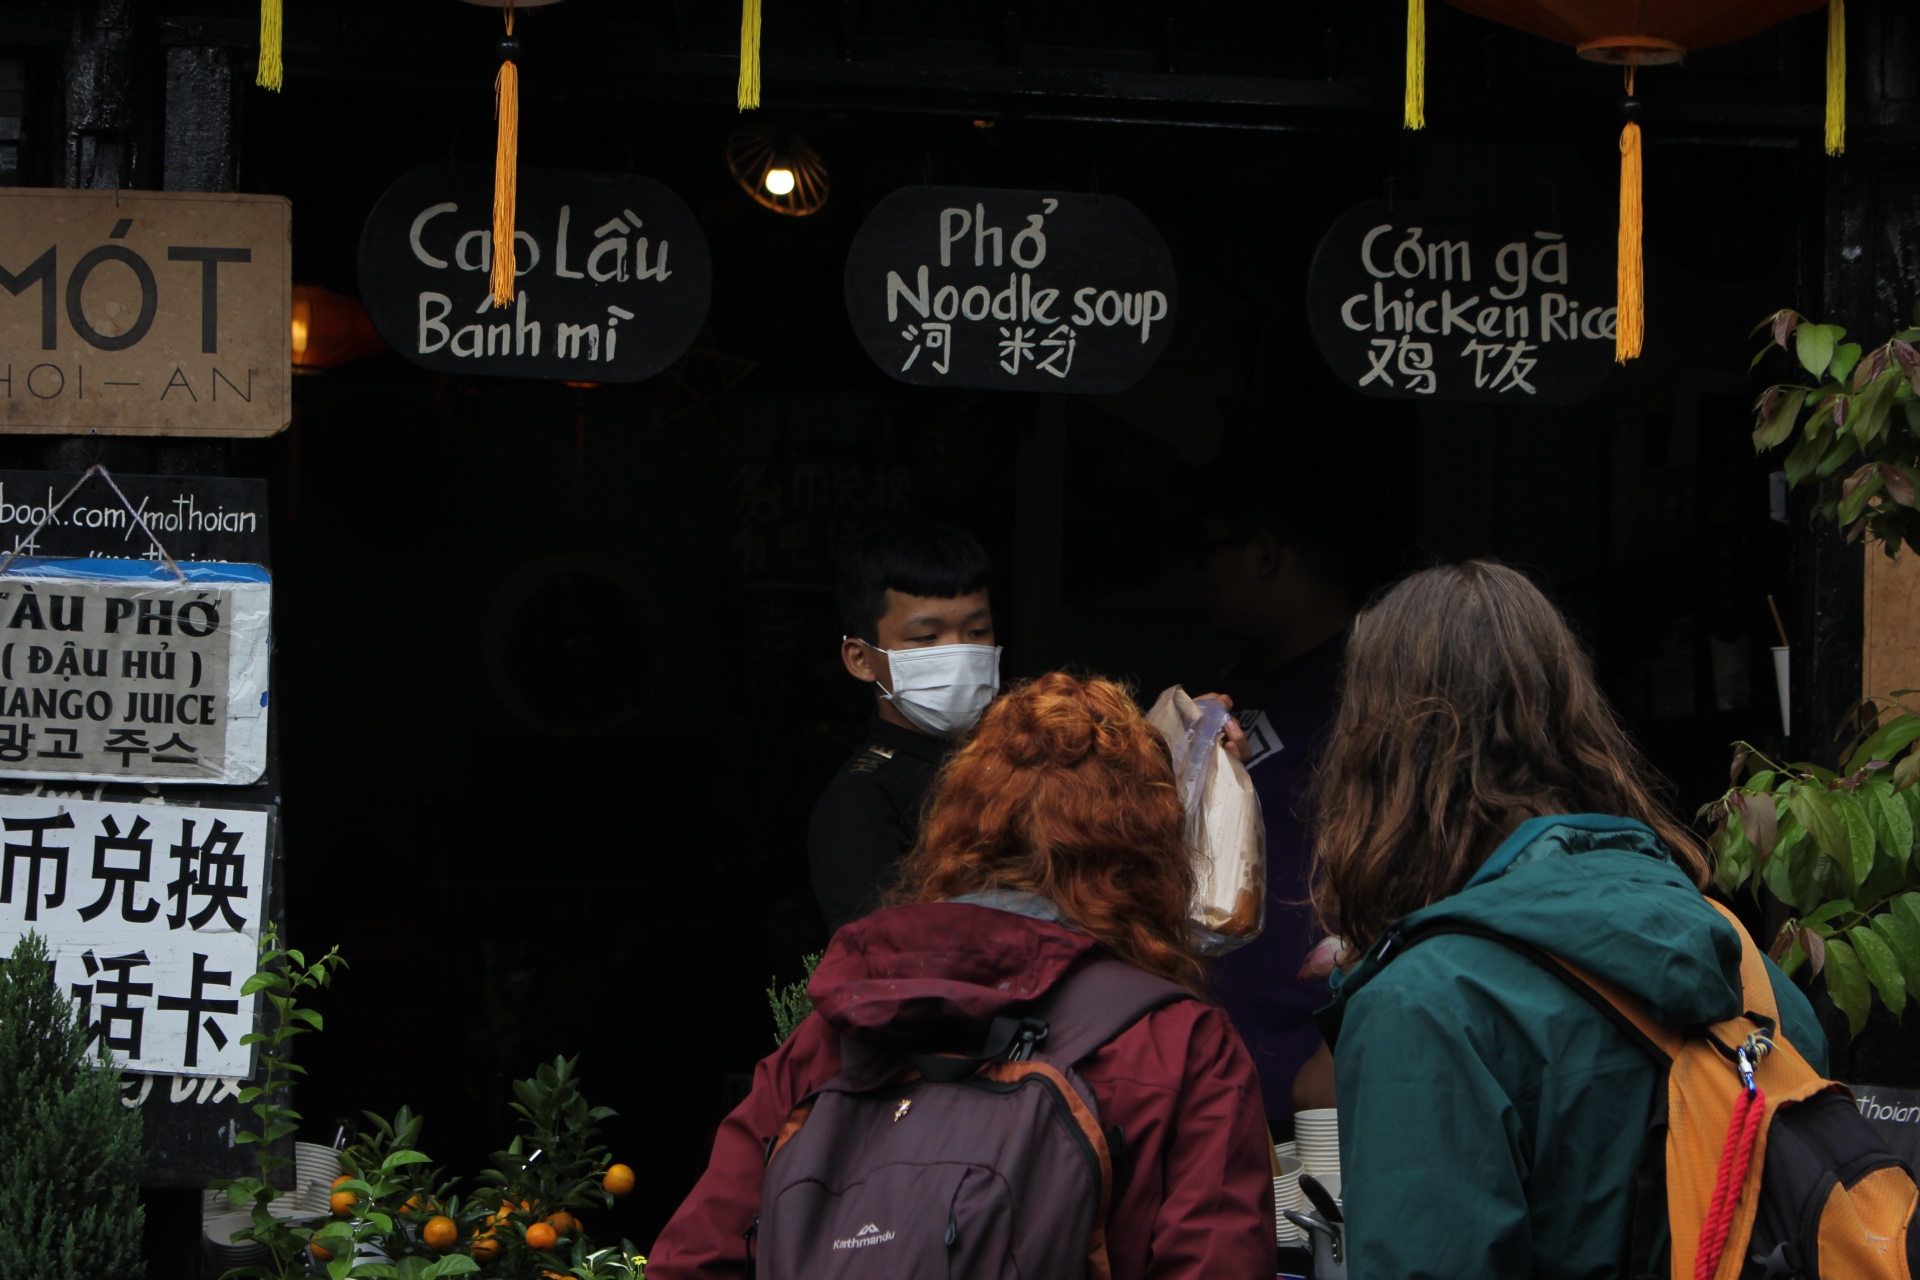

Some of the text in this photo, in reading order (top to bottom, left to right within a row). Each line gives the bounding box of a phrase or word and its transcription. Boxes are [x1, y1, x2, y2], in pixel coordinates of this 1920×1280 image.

[940, 198, 1059, 269] Phở
[0, 218, 252, 354] MÓT
[886, 264, 1169, 345] Noodle soup
[417, 290, 542, 359] Bánh
[0, 584, 85, 632] ÀU
[0, 686, 217, 726] ANGO JUICE
[103, 728, 199, 768] 주스
[1, 811, 249, 933] 币兑换
[0, 947, 240, 1068] 话卡
[832, 1229, 896, 1251] Kathmandu
